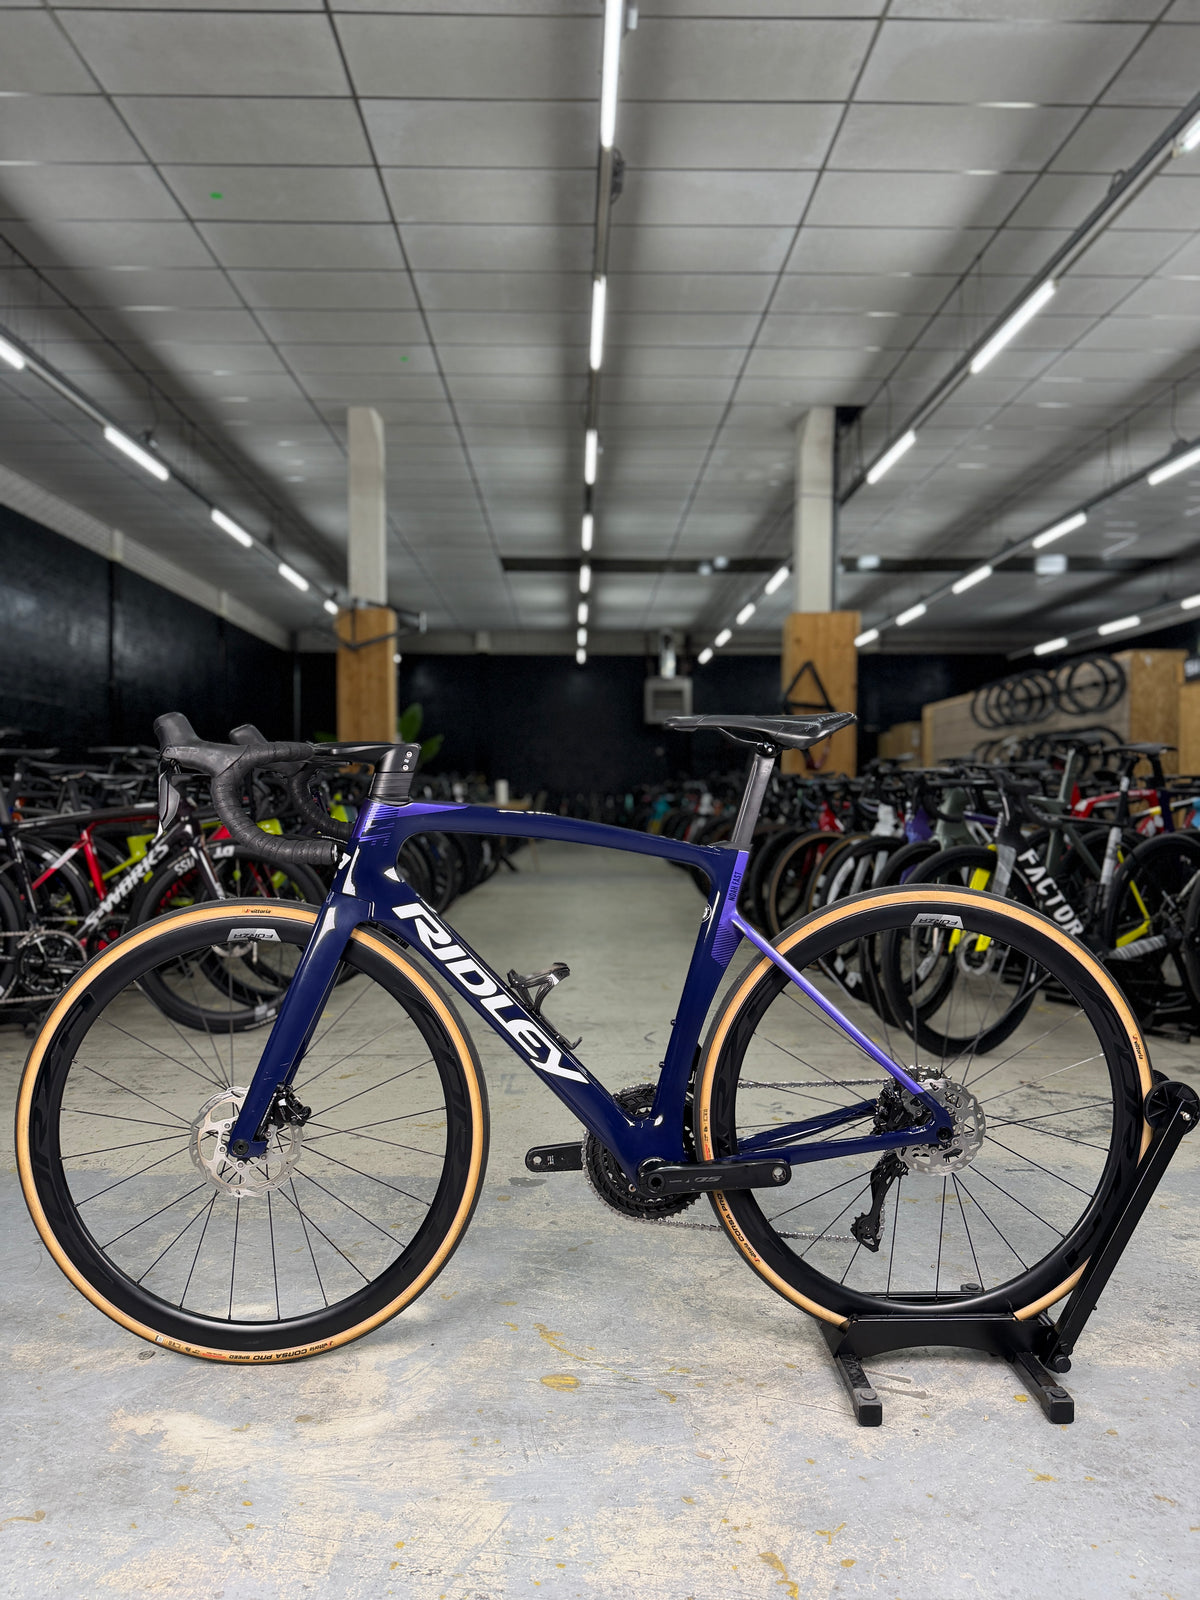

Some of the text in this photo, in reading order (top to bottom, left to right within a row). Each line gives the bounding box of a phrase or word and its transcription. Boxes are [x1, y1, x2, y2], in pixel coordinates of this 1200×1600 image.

[84, 844, 169, 932] S-WORKS
[728, 871, 742, 901] NOAH FAST
[1017, 847, 1084, 936] FACTOR
[391, 902, 590, 1084] RIDLEY
[725, 1213, 745, 1242] CORSA
[275, 1348, 308, 1359] CORSA
